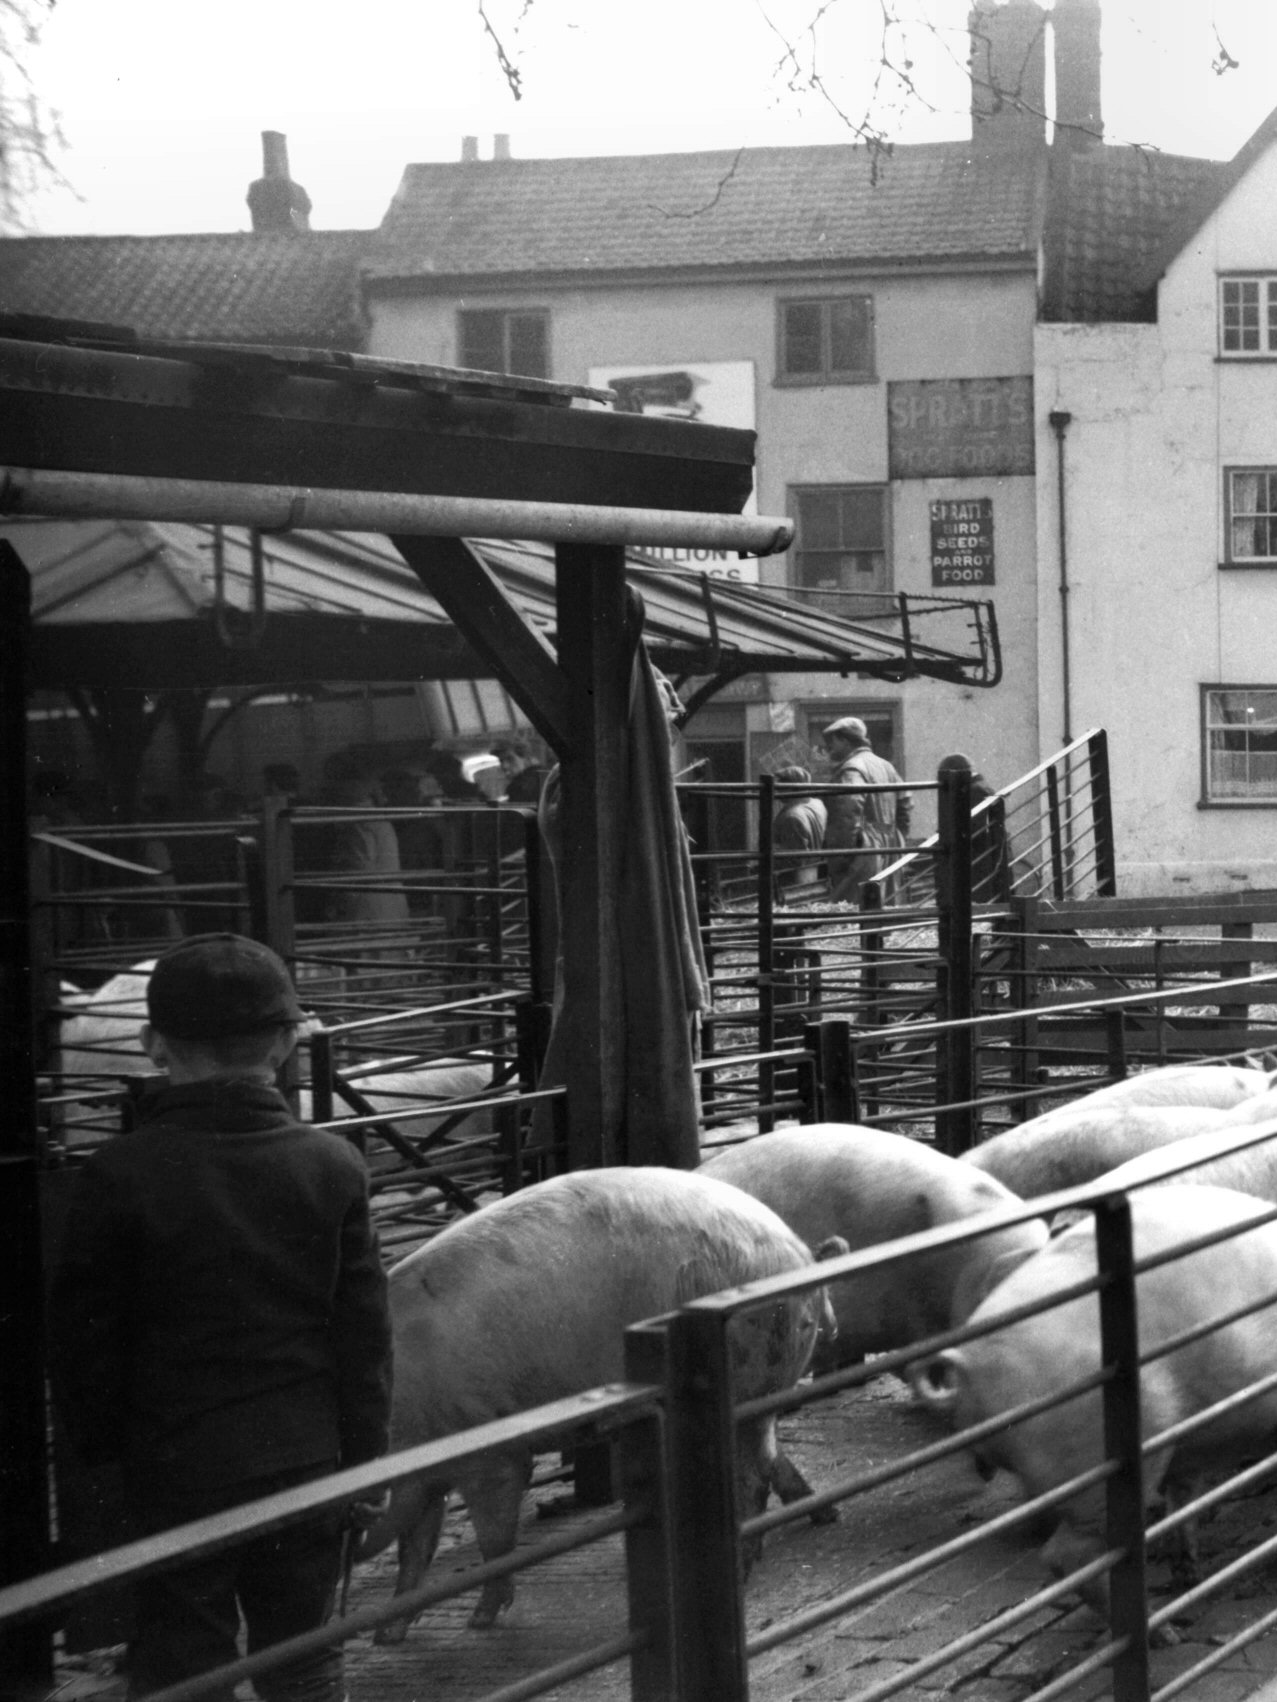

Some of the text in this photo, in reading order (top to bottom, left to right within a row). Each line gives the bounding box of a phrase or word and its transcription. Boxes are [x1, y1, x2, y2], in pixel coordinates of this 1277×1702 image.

[943, 523, 980, 534] BIRD
[937, 536, 989, 549] SEEDS
[934, 555, 991, 567] PARROT
[943, 569, 983, 580] FOOD
